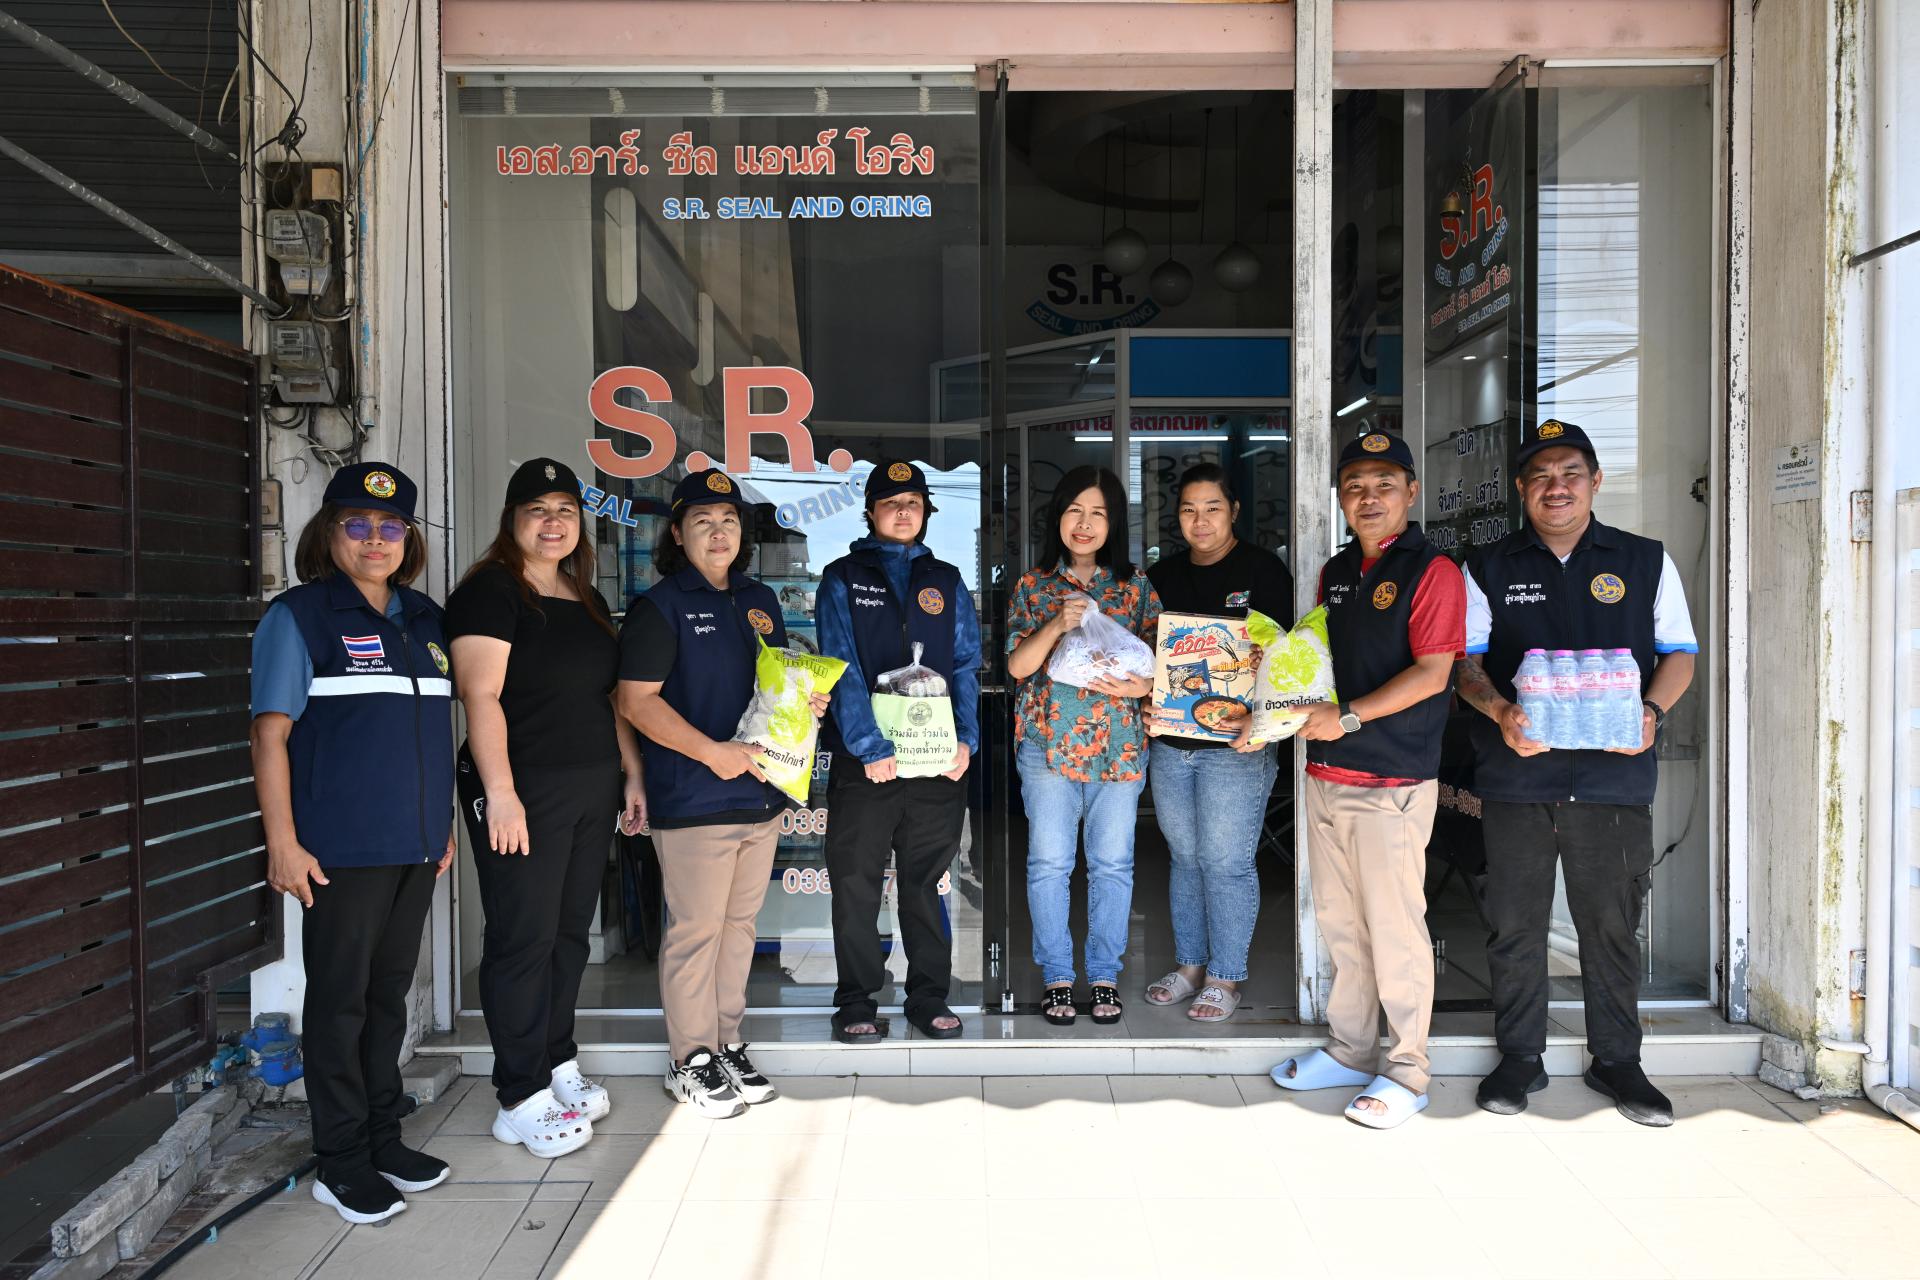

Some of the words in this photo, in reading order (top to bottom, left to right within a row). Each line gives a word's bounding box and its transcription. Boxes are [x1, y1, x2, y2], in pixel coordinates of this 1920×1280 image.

[497, 129, 649, 175] เอส.อาร์.
[663, 132, 717, 175] ซีล
[735, 129, 835, 175] แอนด์
[846, 127, 934, 175] โอริง
[663, 199, 709, 219] S.R.
[717, 198, 781, 219] SEAL
[789, 197, 844, 218] AND
[851, 196, 931, 217] ORING
[1458, 263, 1476, 286] AND
[1481, 216, 1508, 267] ORING
[1047, 264, 1135, 305] S.R.
[1031, 306, 1064, 330] SEAL
[1073, 320, 1102, 335] AND
[586, 366, 853, 478] S.R.
[1457, 427, 1474, 457] เปิด
[1438, 478, 1463, 513] จันทร์
[1475, 467, 1500, 505] เสาร์
[922, 726, 949, 738] ร่วมใจ
